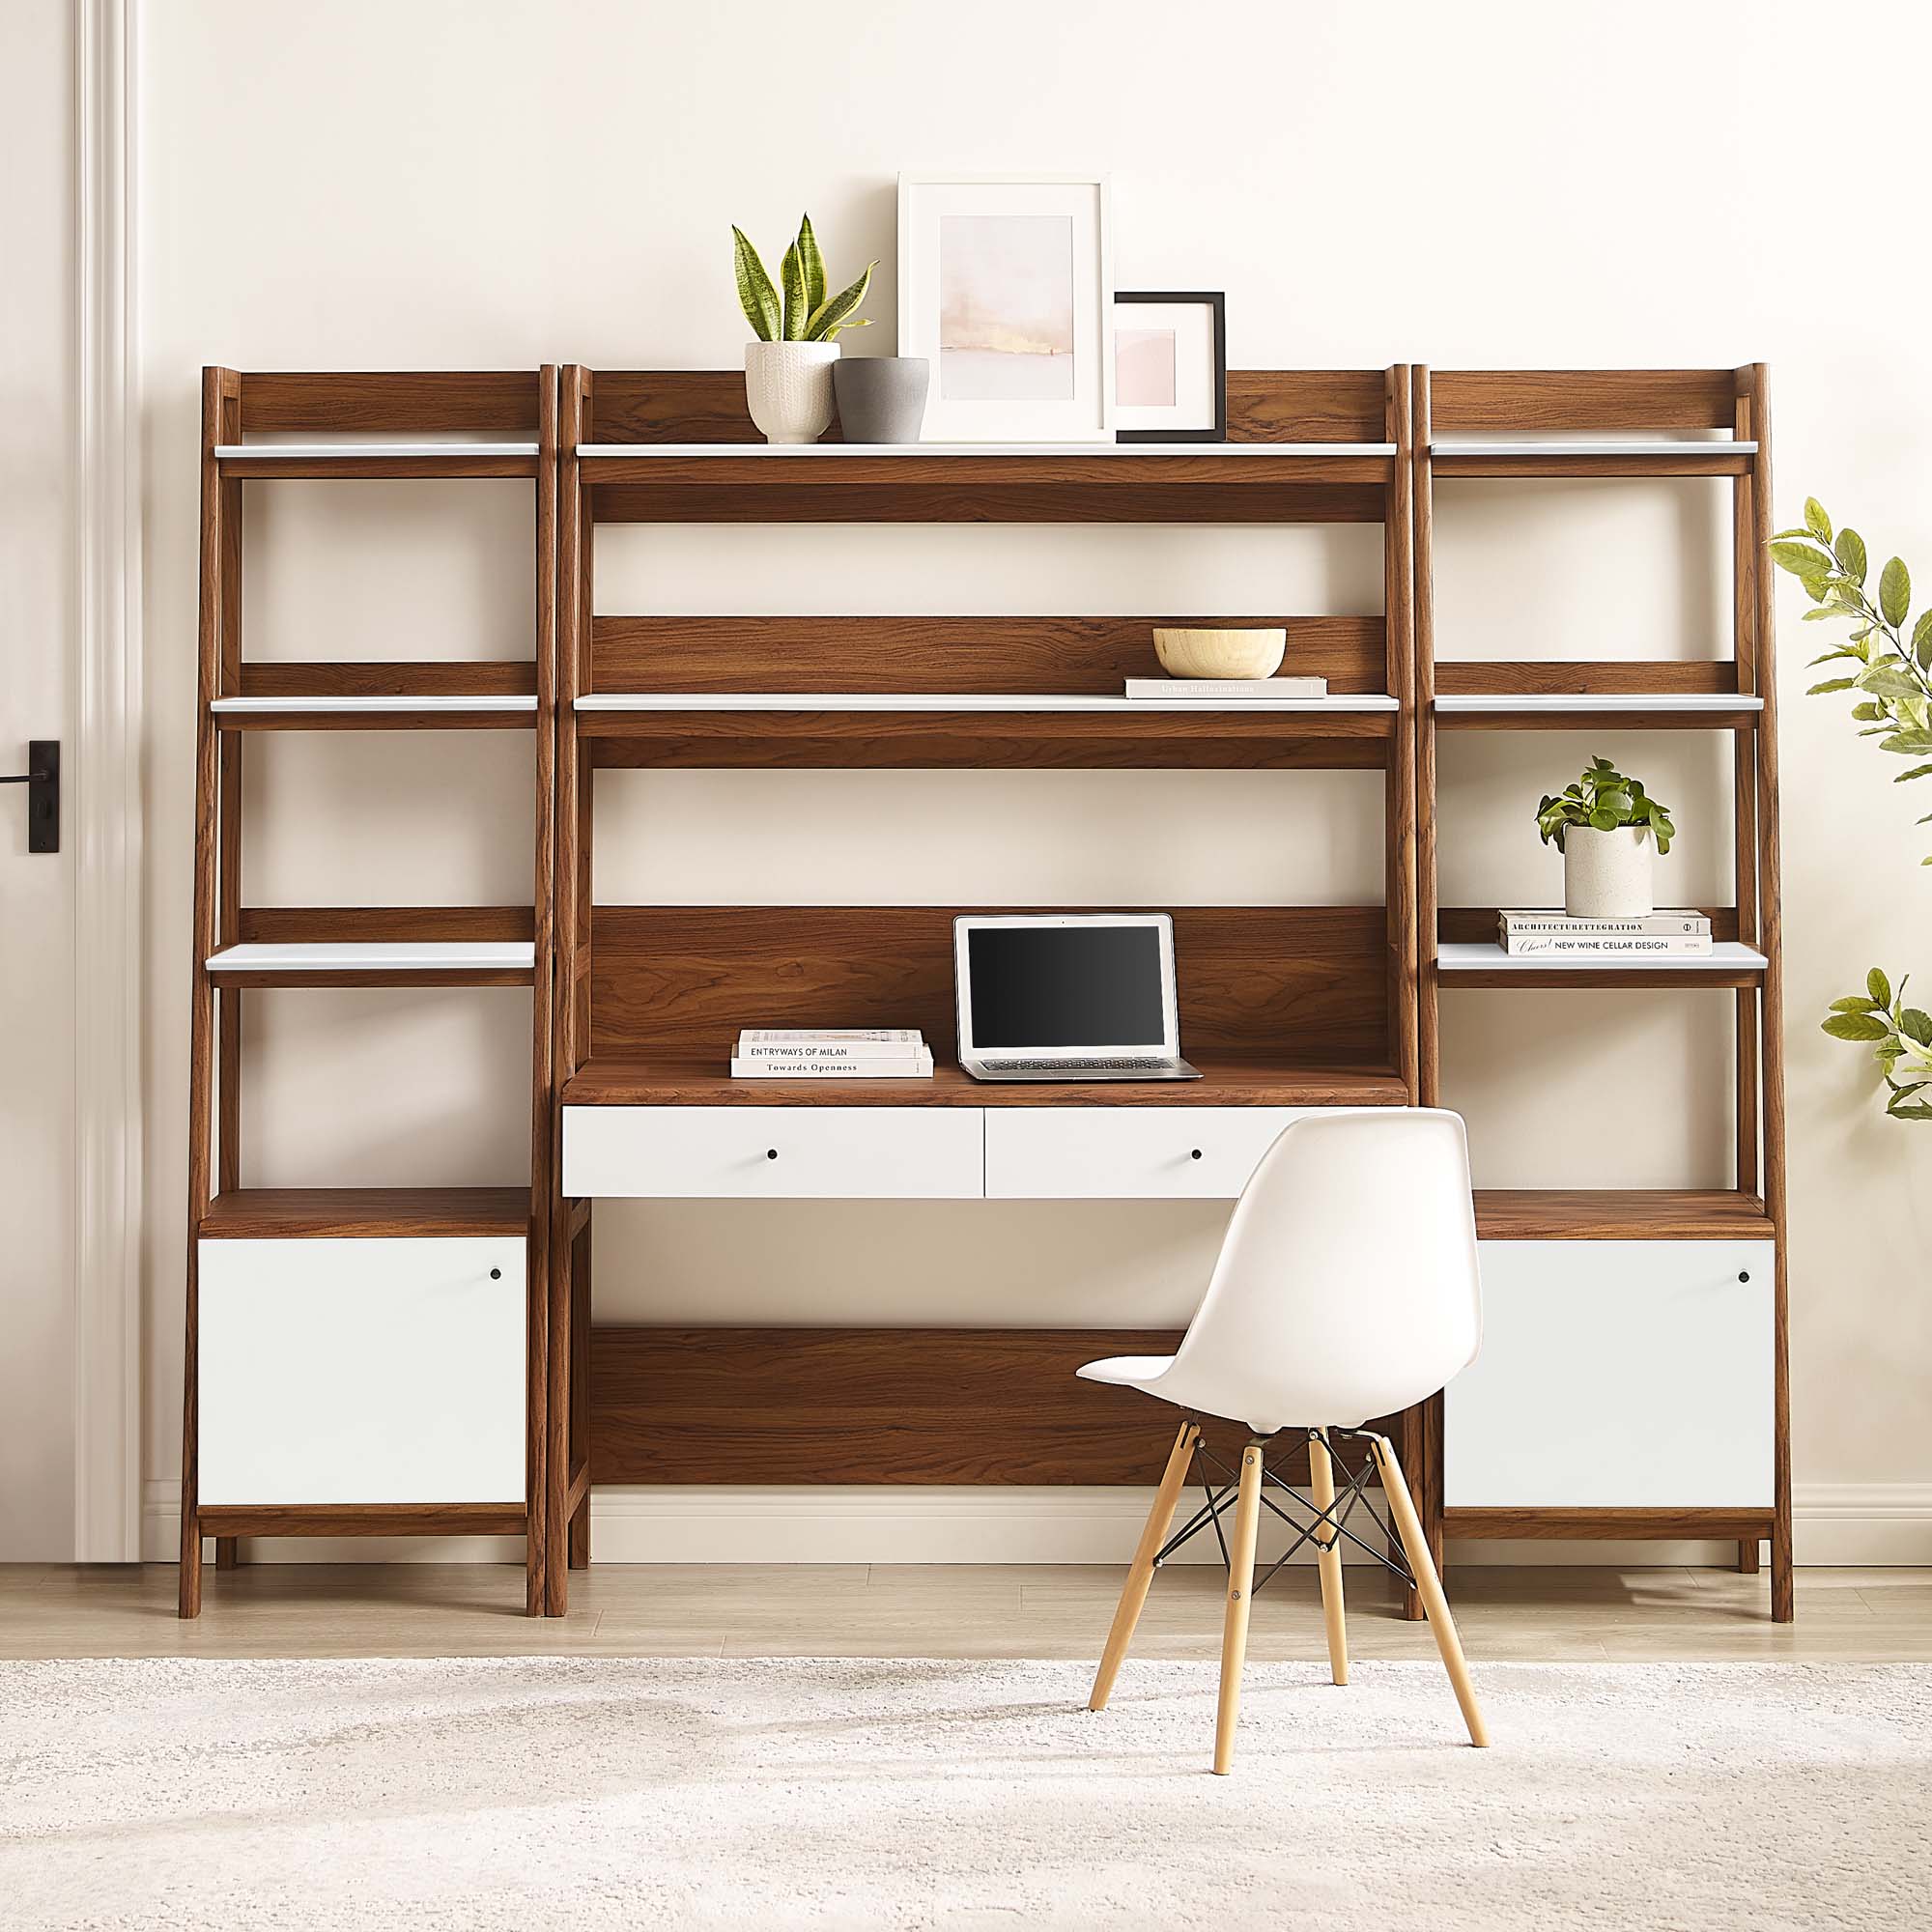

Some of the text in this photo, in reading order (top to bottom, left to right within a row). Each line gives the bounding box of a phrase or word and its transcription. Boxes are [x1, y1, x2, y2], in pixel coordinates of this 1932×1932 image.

[751, 1047, 847, 1057] ENTRYWAYS OF MILAN
[810, 1064, 858, 1073] Openness
